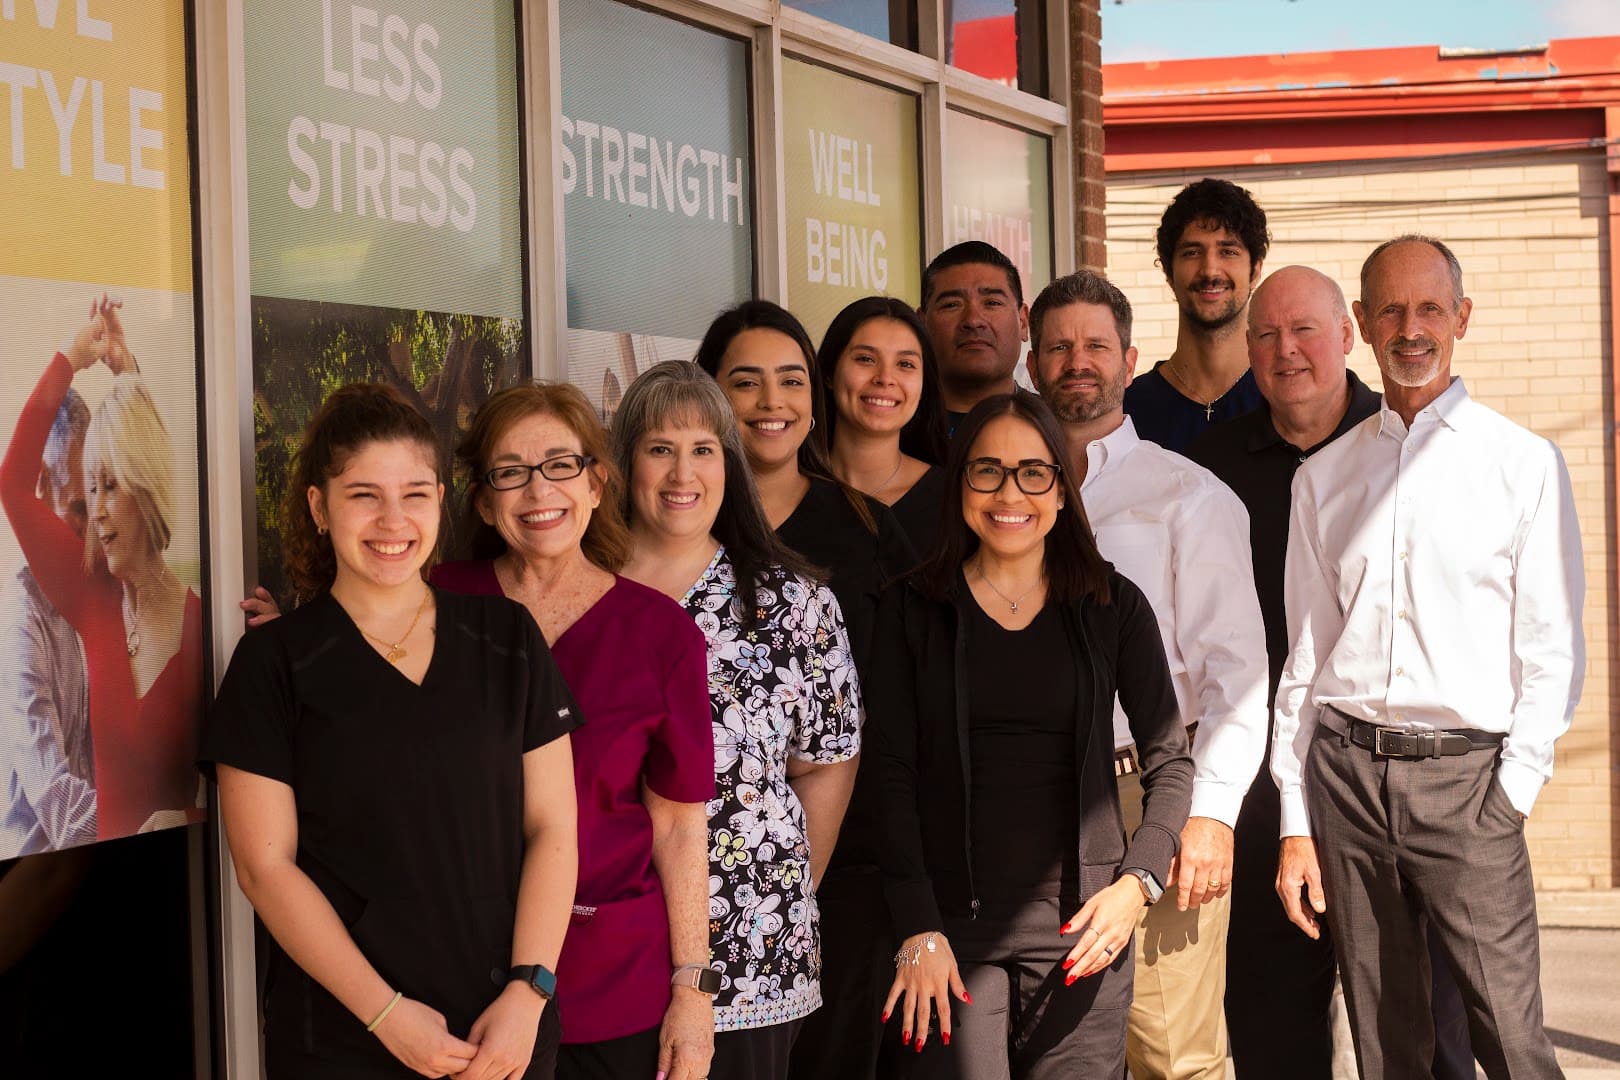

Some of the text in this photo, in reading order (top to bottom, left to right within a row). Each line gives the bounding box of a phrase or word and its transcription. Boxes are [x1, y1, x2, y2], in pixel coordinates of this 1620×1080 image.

[323, 0, 443, 109] LESS
[0, 61, 165, 190] TYLE
[287, 116, 477, 232] STRESS
[562, 114, 744, 226] STRENGTH
[808, 128, 881, 207] WELL
[806, 217, 888, 292] BEING
